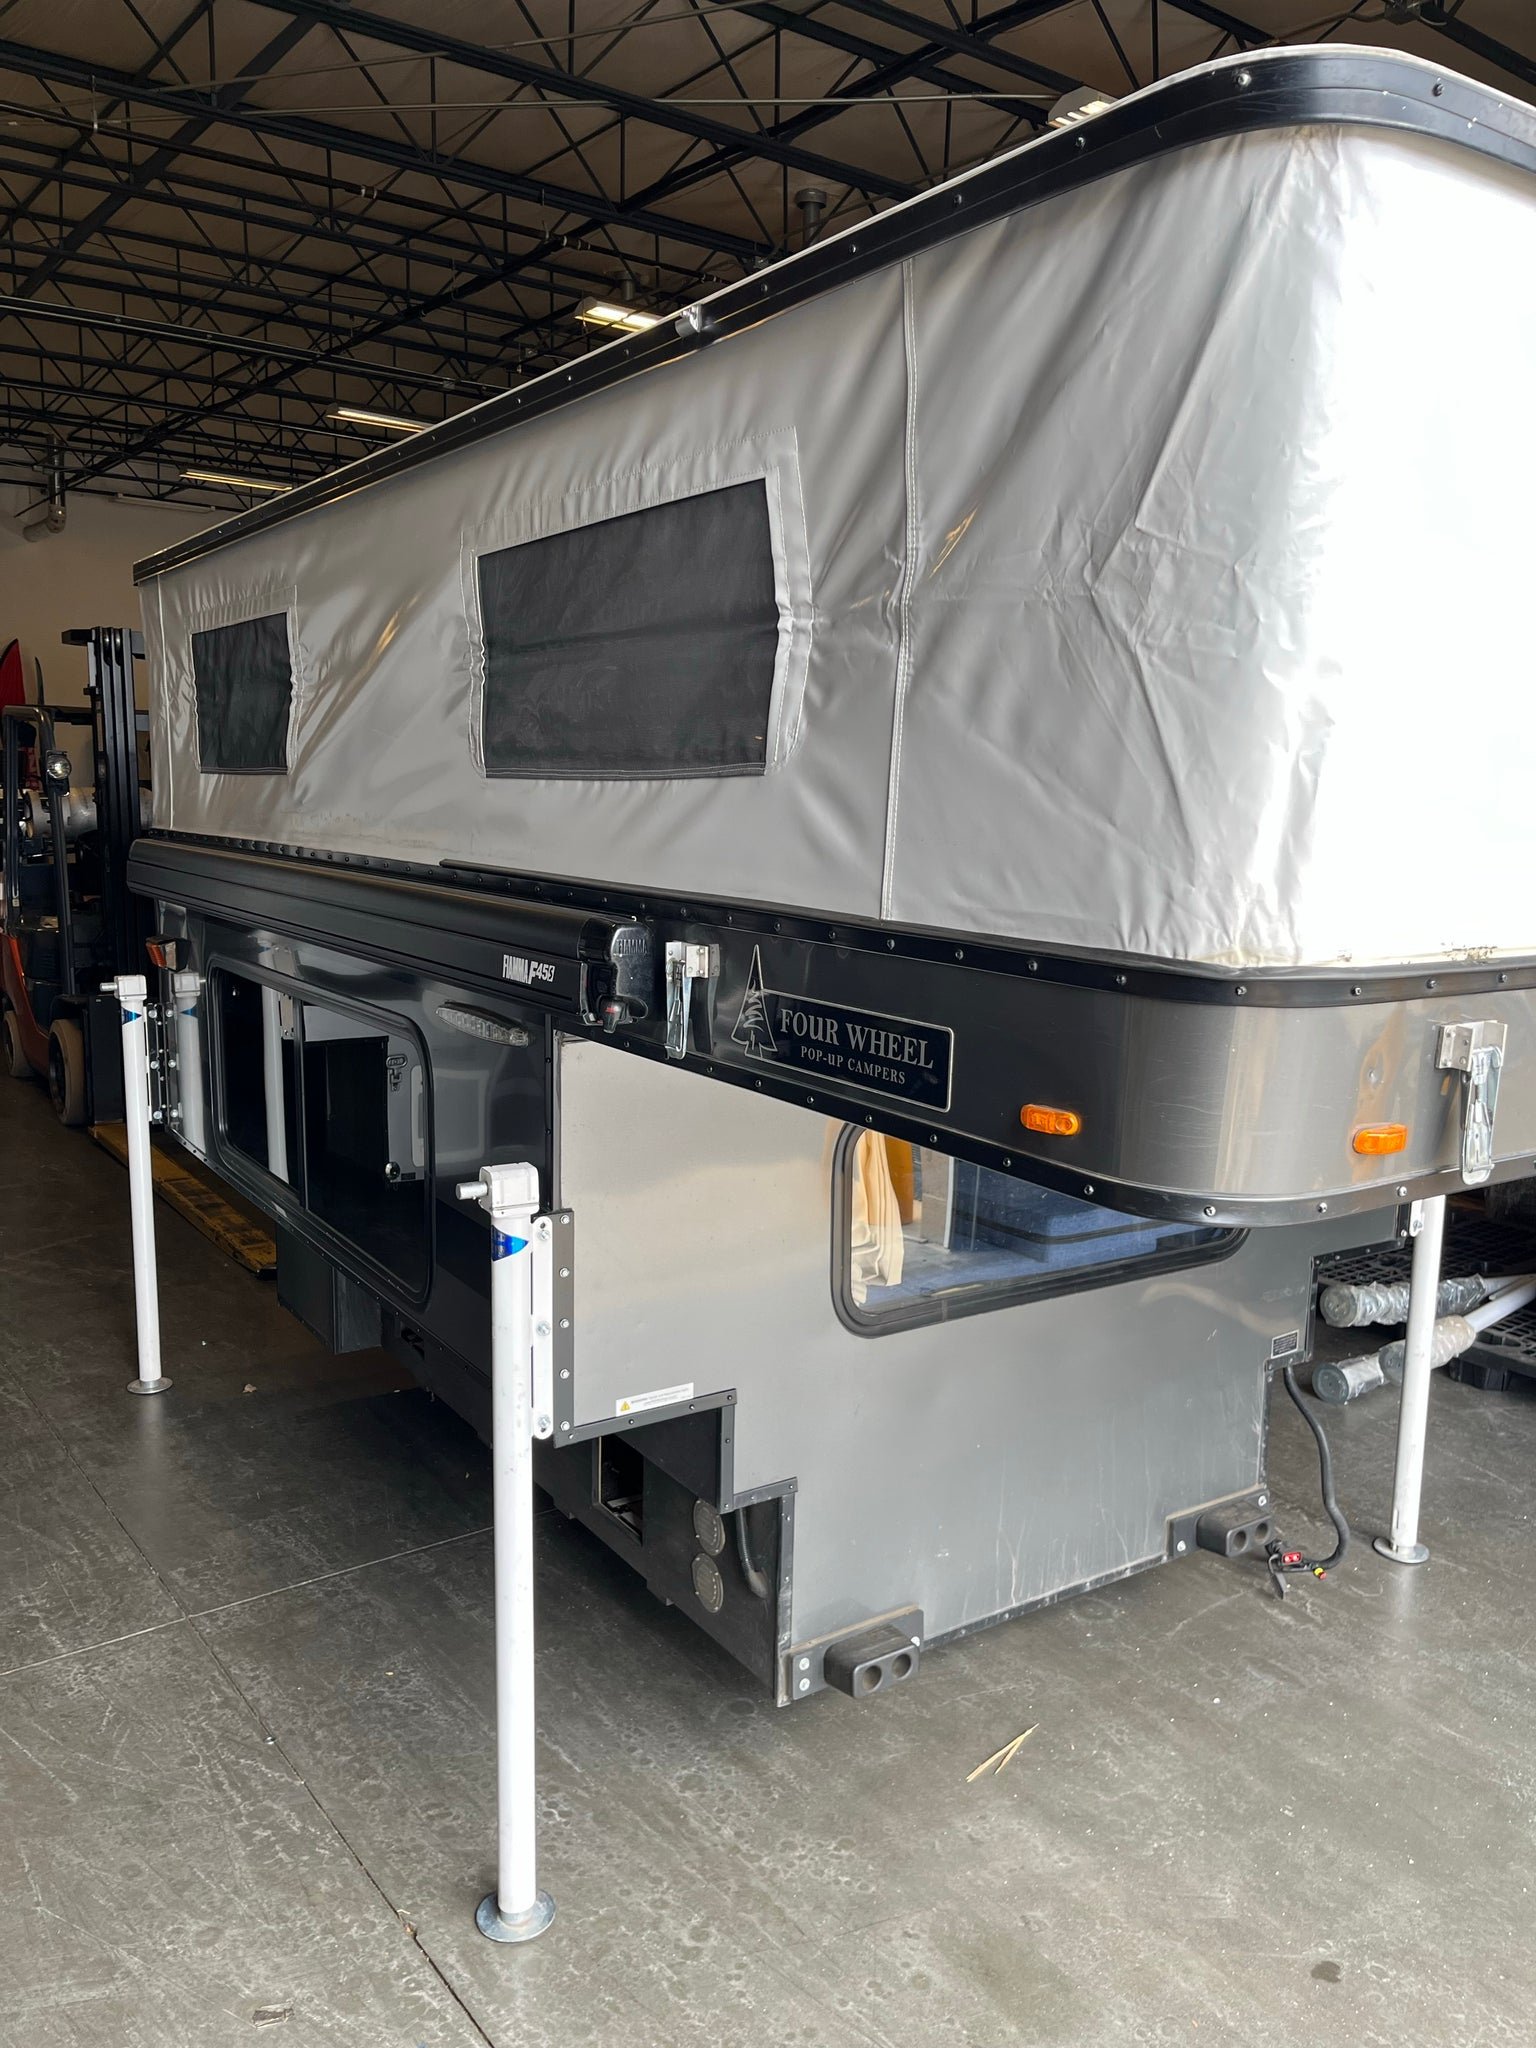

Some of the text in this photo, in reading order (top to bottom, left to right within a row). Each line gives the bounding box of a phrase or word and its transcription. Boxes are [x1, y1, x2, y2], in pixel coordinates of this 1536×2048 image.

[502, 954, 529, 984] FIAMMA
[780, 1008, 934, 1069] FOUR WHEEL
[801, 1045, 906, 1085] POP-UP CAMPERS
